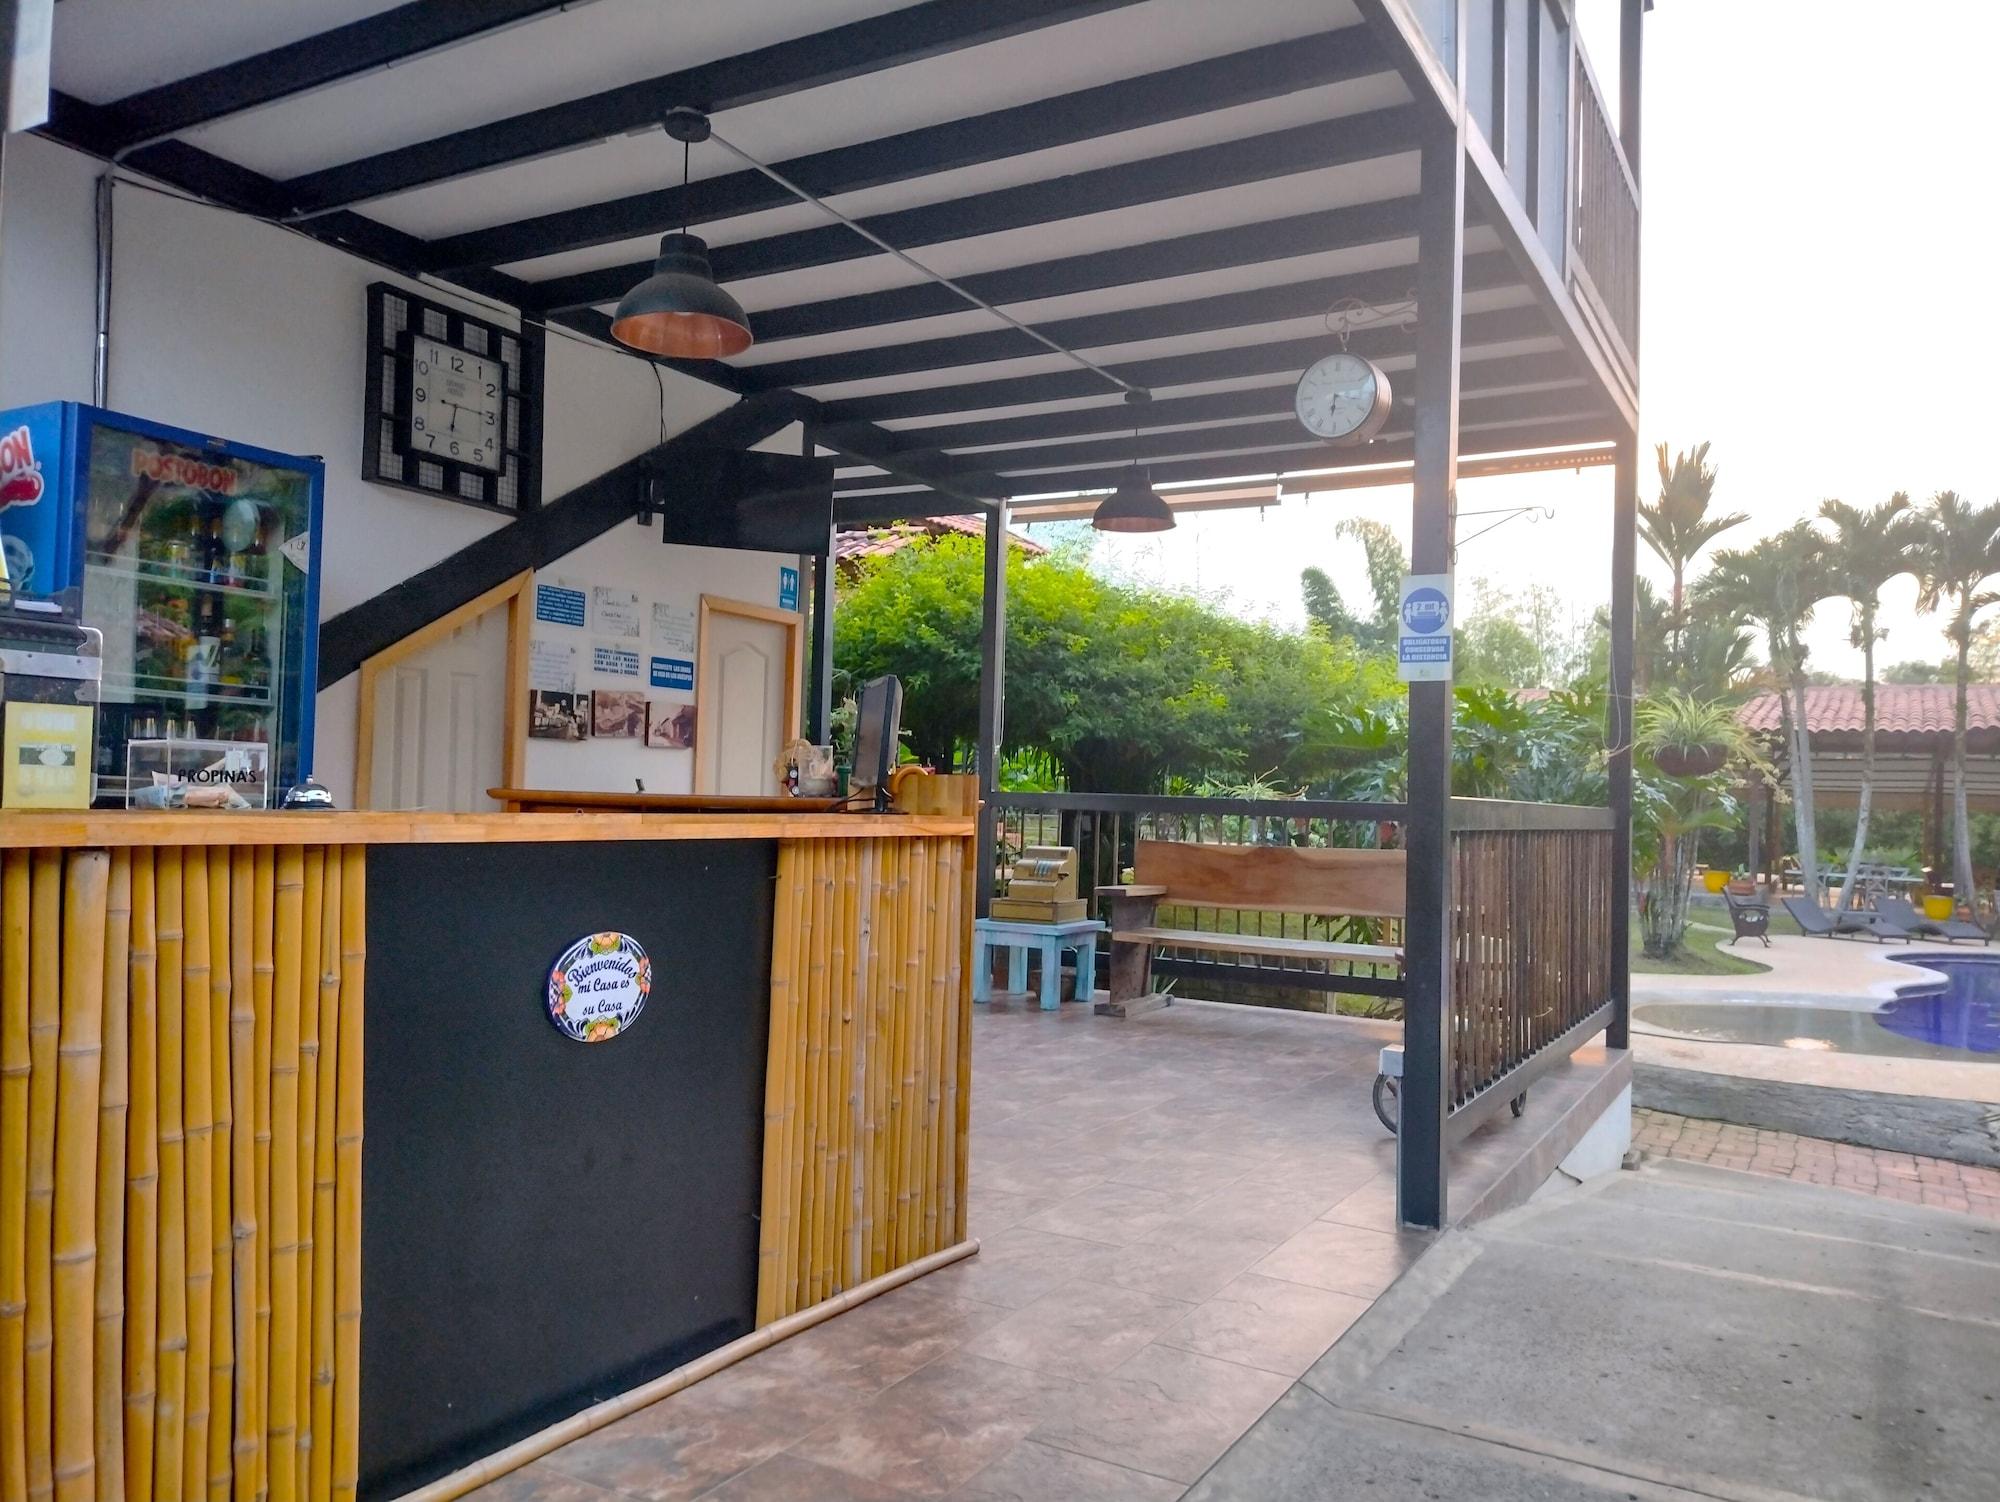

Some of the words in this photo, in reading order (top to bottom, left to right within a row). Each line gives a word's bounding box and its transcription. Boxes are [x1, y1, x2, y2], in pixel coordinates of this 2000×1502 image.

[415, 359, 429, 375] 10
[430, 348, 439, 365] 11
[451, 356, 464, 373] 12
[415, 387, 426, 402] 9
[485, 383, 496, 398] 2
[414, 416, 425, 431] 8
[485, 410, 495, 425] 3
[425, 434, 436, 448] 7
[450, 441, 460, 455] 6
[473, 448, 483, 462] 5
[485, 438, 494, 452] 4
[568, 957, 636, 987] Bienvenidos
[578, 981, 591, 994] mi
[593, 977, 618, 992] Casa
[620, 979, 630, 988] es
[582, 1005, 596, 1015] su
[598, 999, 624, 1012] Casa
